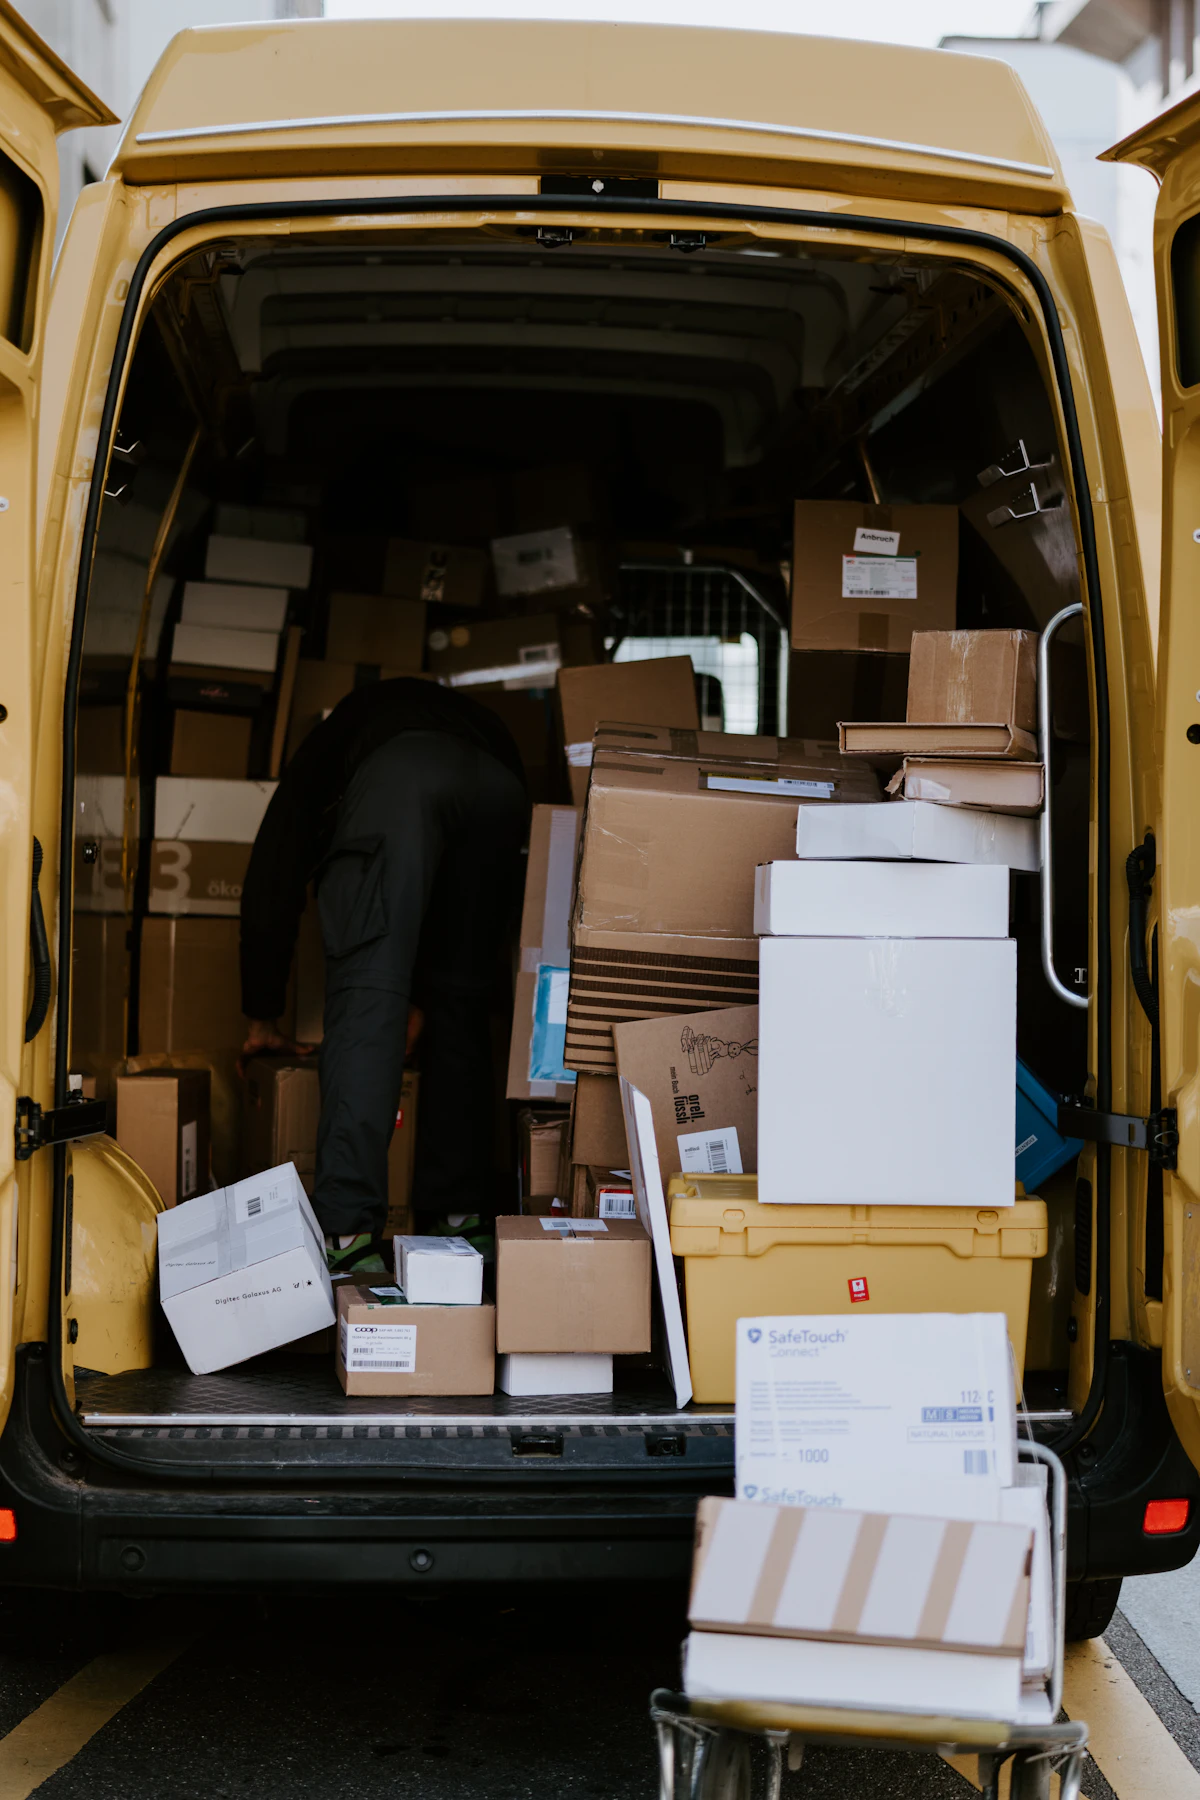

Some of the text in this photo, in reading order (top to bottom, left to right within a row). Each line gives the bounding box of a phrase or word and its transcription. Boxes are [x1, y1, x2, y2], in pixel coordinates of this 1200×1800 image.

[860, 533, 895, 543] Anbruch
[215, 1286, 282, 1305] Digitec Galaxus AG
[798, 1449, 829, 1463] 1000
[761, 1486, 843, 1507] SafeTouch
